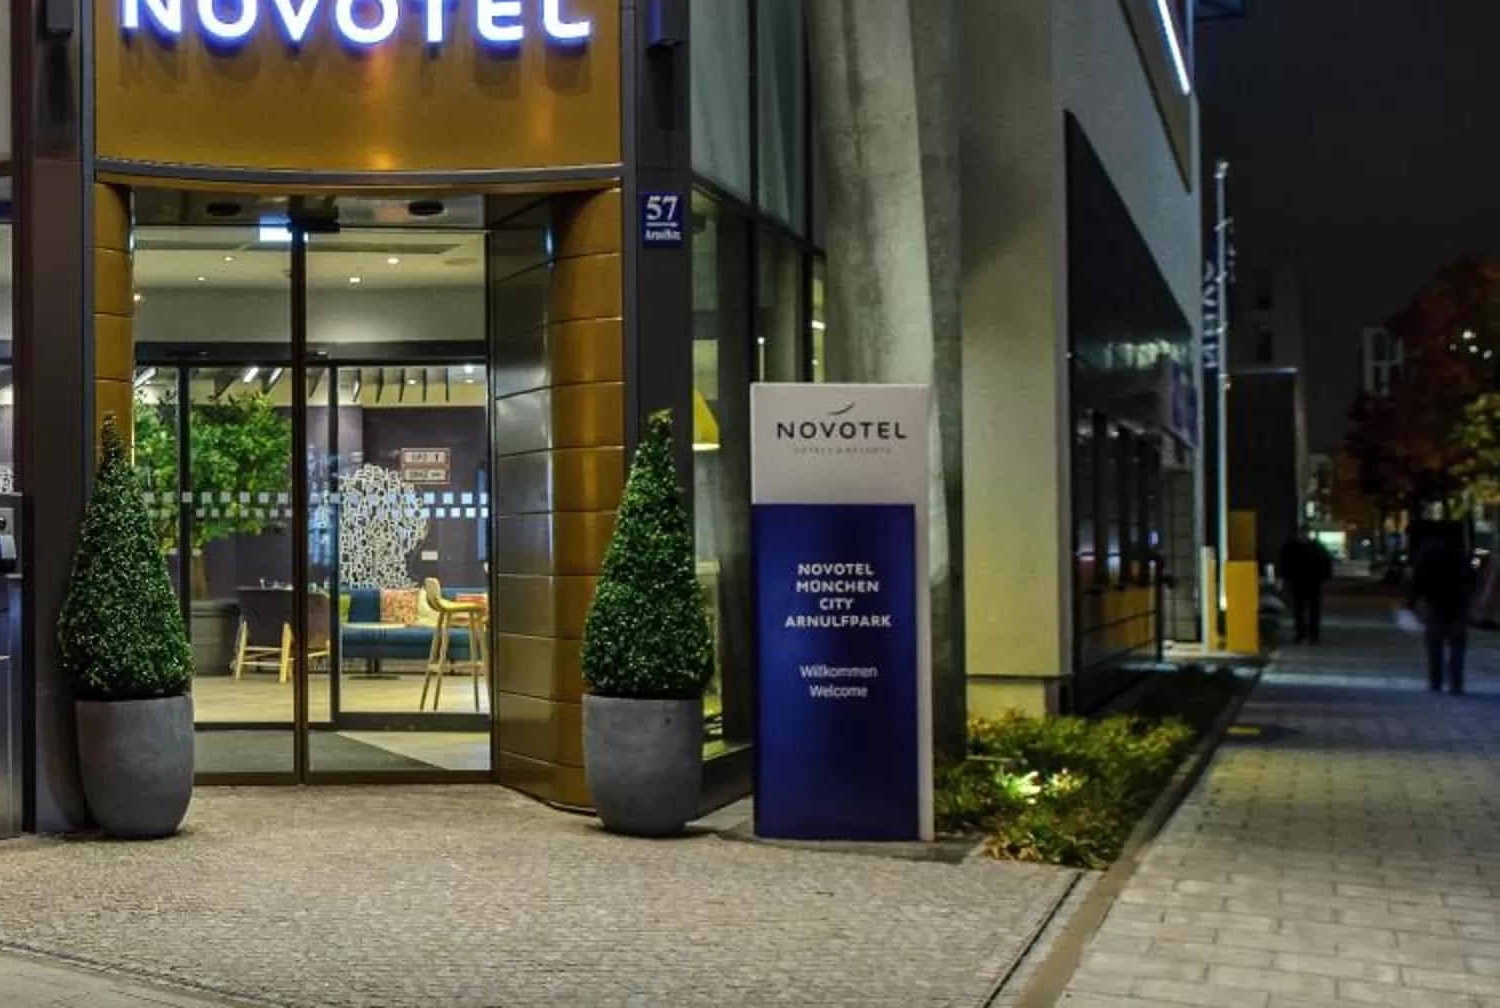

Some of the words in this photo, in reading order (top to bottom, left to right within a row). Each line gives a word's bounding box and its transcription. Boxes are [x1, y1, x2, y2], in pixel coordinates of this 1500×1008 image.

[646, 195, 678, 221] 57
[776, 421, 908, 440] NOVOTEL
[797, 563, 875, 576] NOVOTEL
[819, 597, 855, 611] CITY
[784, 615, 893, 628] ARNULFPARK
[799, 664, 879, 678] Willkommen
[808, 684, 869, 698] Welcome
